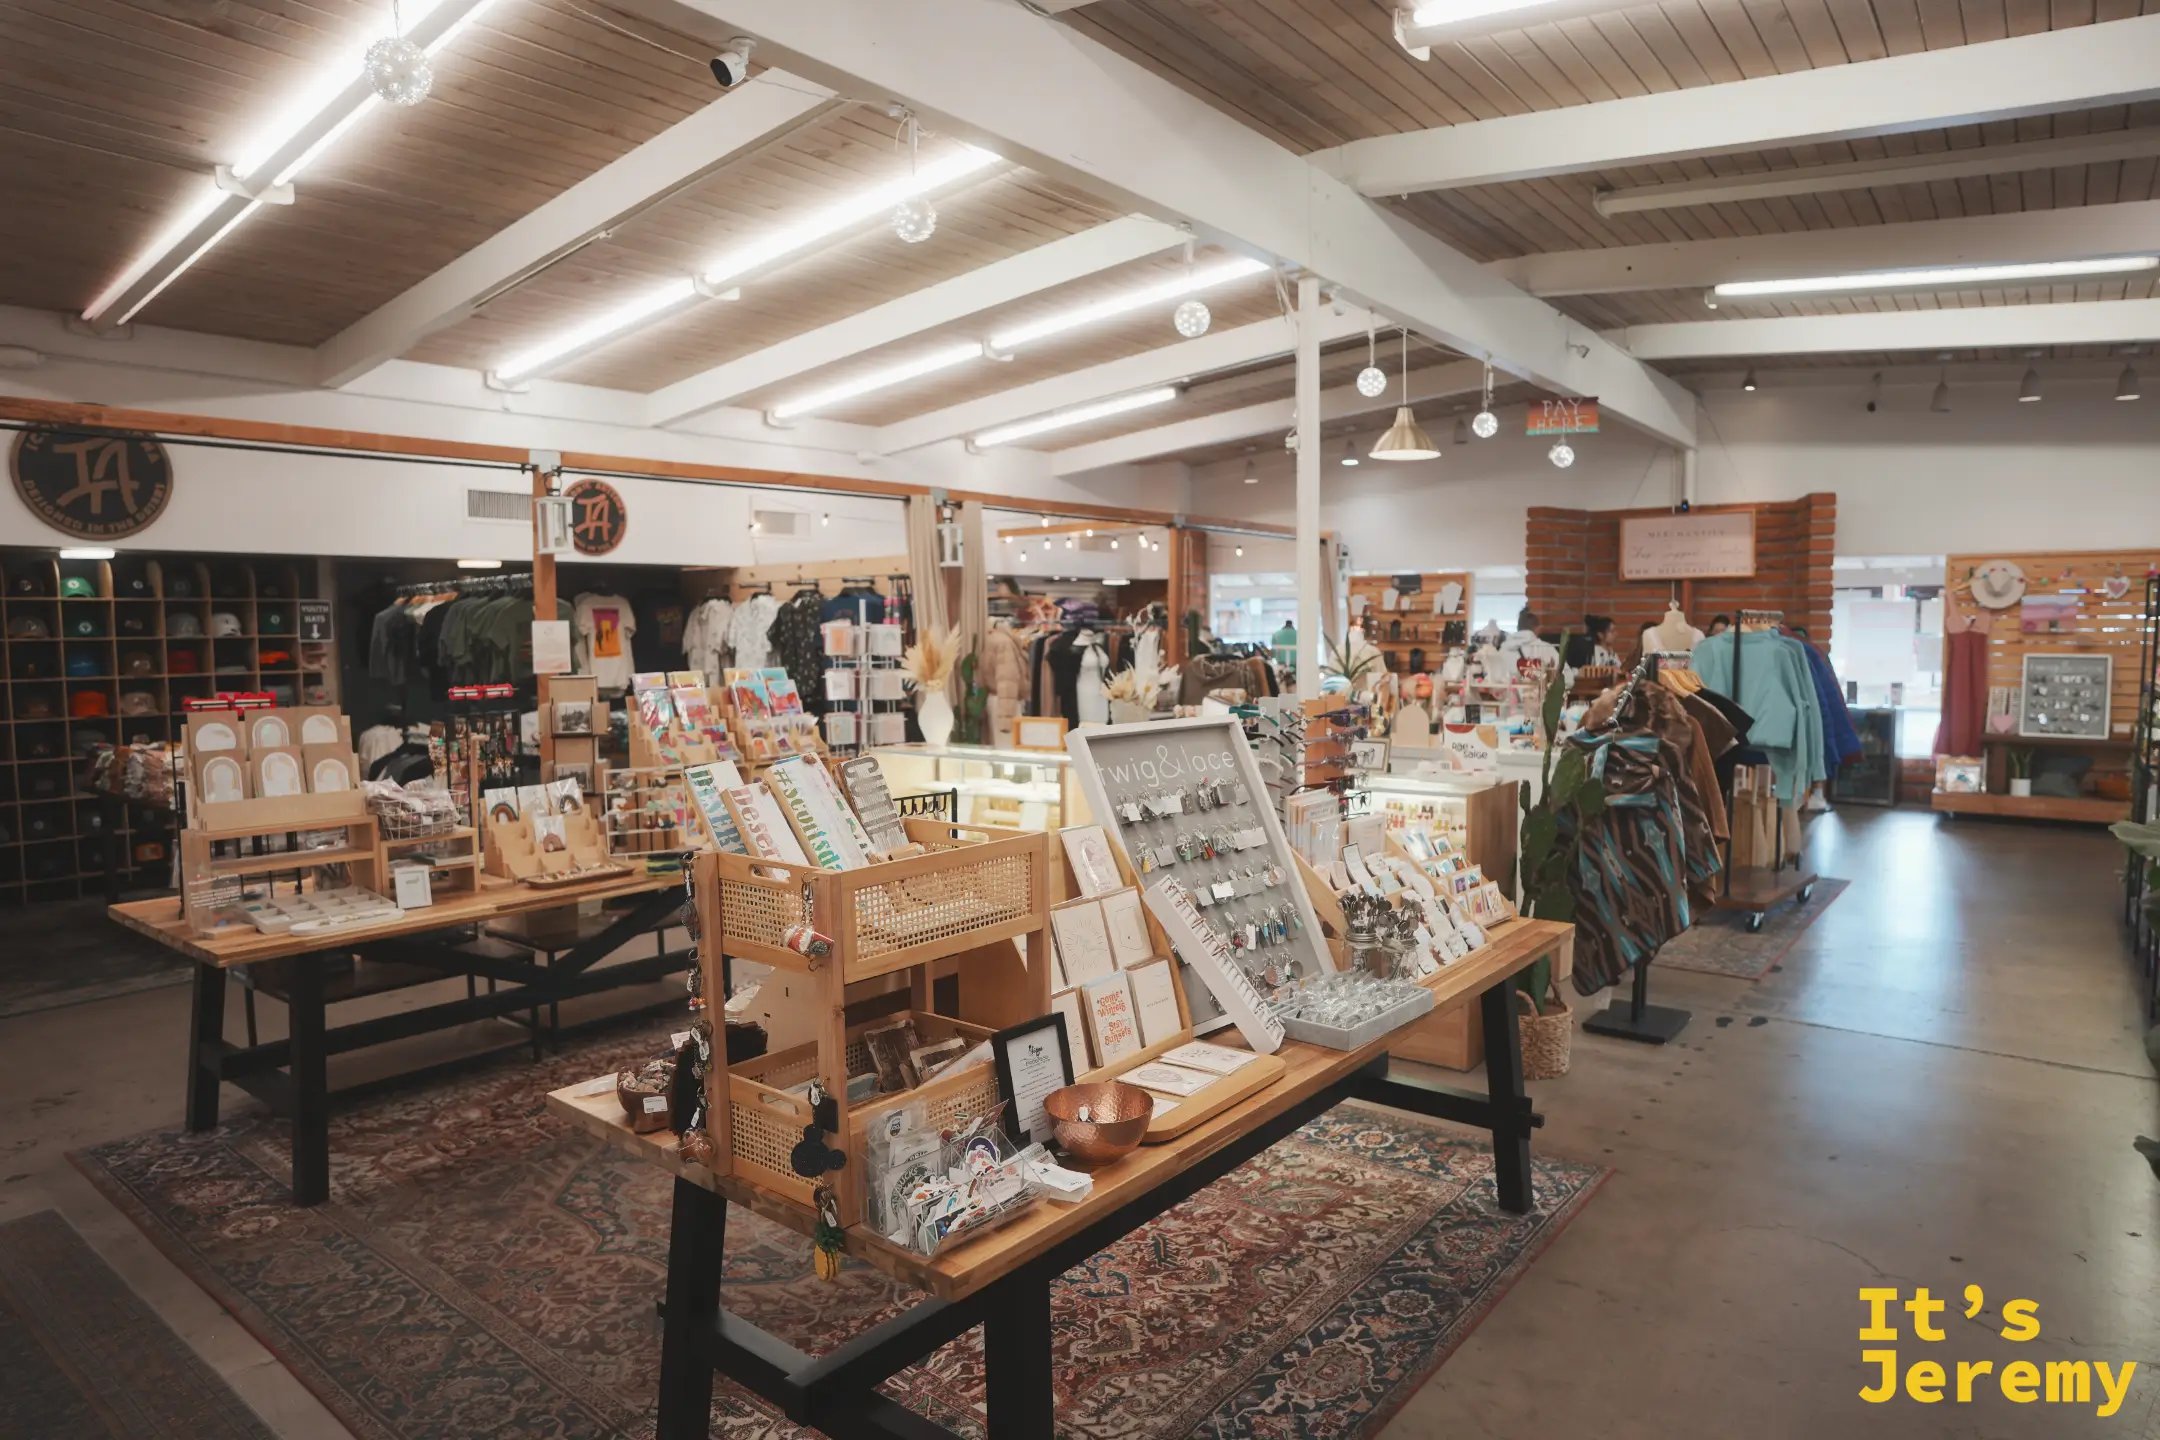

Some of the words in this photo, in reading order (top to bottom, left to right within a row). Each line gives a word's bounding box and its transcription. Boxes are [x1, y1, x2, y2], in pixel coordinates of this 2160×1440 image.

[1542, 397, 1583, 417] PAY
[1537, 415, 1589, 434] HERE
[88, 523, 104, 533] IN
[109, 517, 135, 533] THE
[843, 755, 904, 843] CUTIE
[729, 785, 783, 864] Deser
